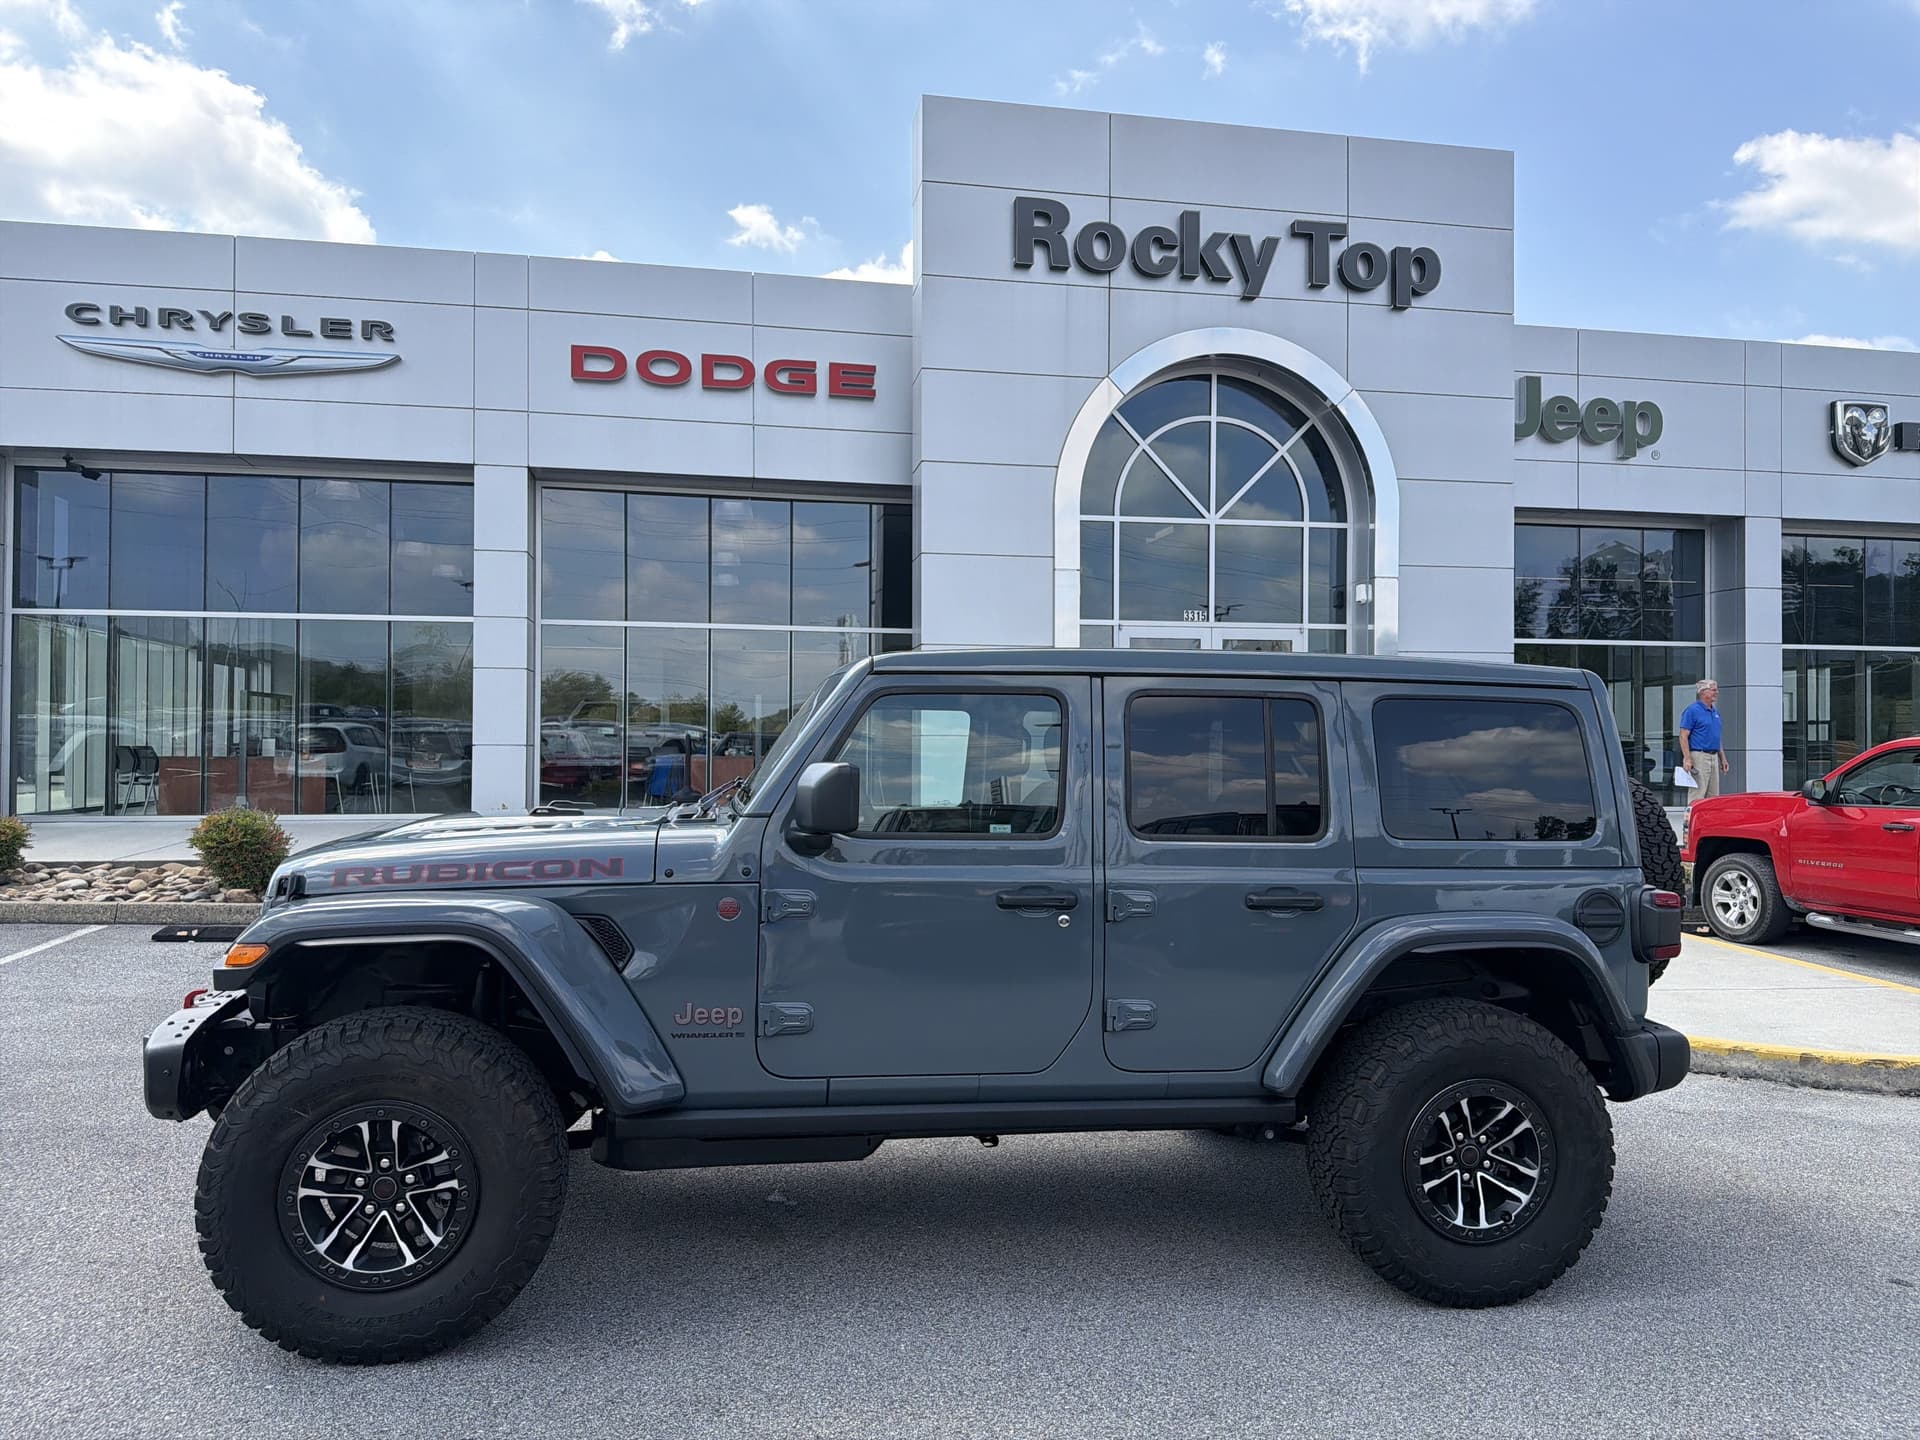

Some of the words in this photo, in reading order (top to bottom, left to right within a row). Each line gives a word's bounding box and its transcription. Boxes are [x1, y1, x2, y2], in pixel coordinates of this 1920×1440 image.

[1013, 196, 1281, 300] Rocky
[1290, 219, 1441, 310] Top
[65, 302, 395, 341] CHRYSLER
[195, 352, 262, 361] CHRYSLER
[571, 344, 876, 399] DODGE
[1514, 375, 1664, 459] Jeep
[1184, 610, 1206, 622] 3315
[333, 857, 624, 887] RUBICON
[674, 1001, 744, 1029] Jeep
